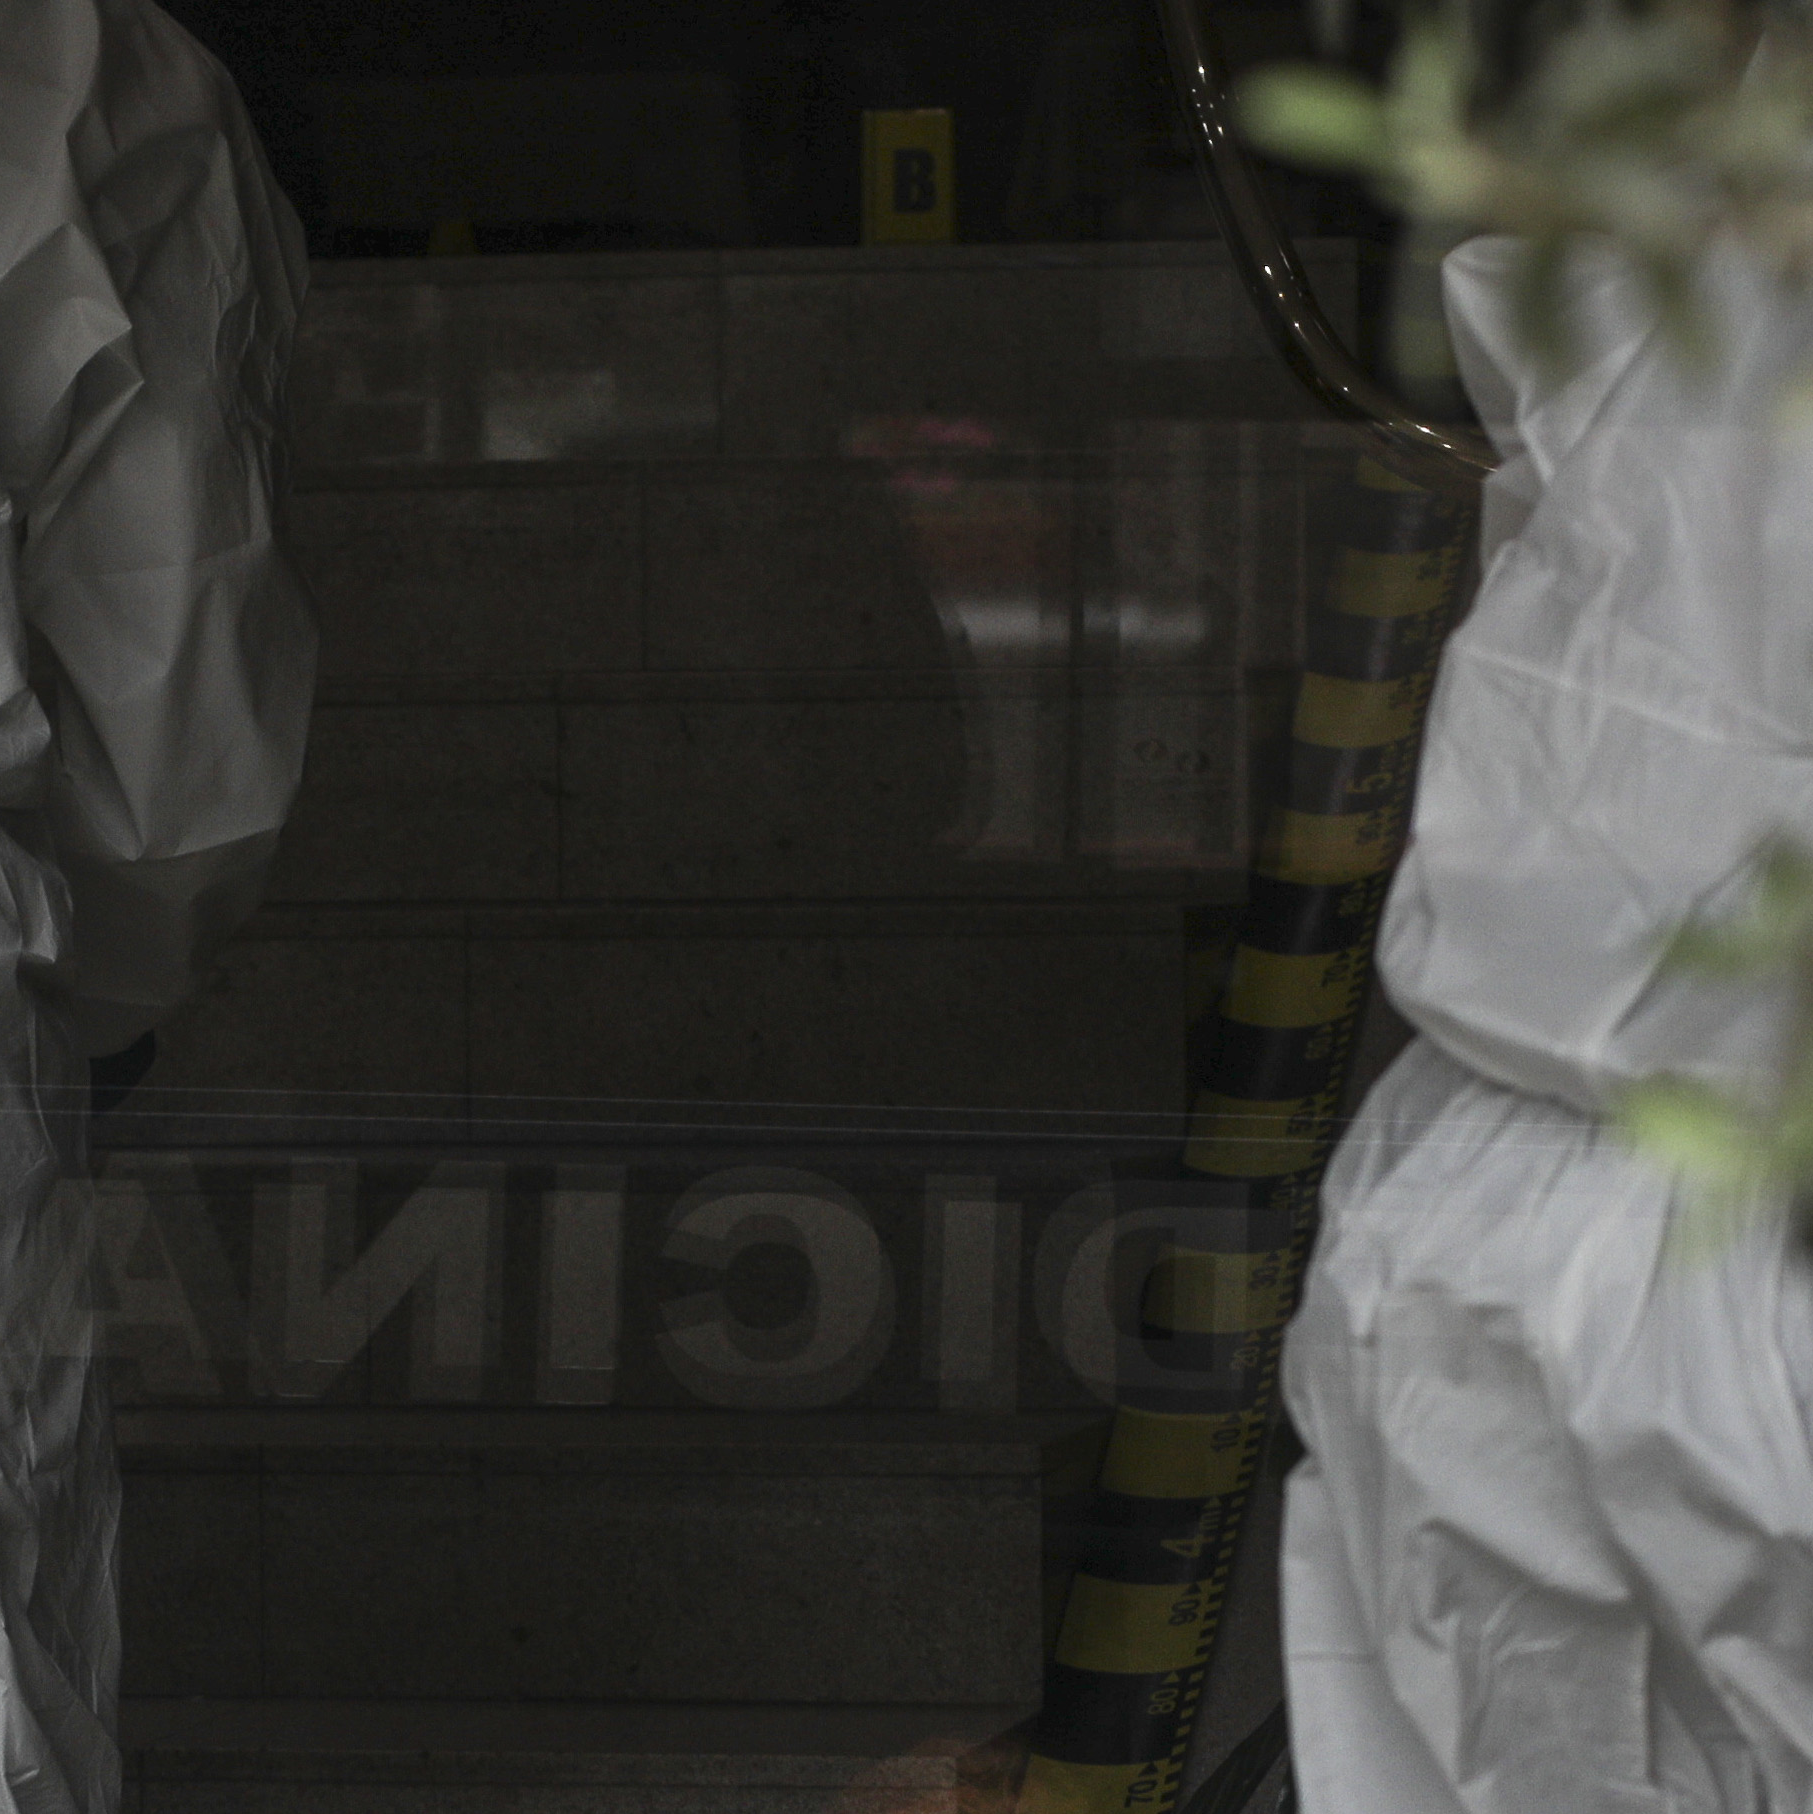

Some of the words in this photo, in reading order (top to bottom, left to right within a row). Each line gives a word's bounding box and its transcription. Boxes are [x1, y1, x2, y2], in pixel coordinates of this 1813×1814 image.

[895, 149, 936, 213] B
[1211, 1428, 1242, 1452] 10
[1168, 1598, 1202, 1626] 90
[1146, 1688, 1180, 1716] 80
[1124, 1779, 1158, 1808] 70
